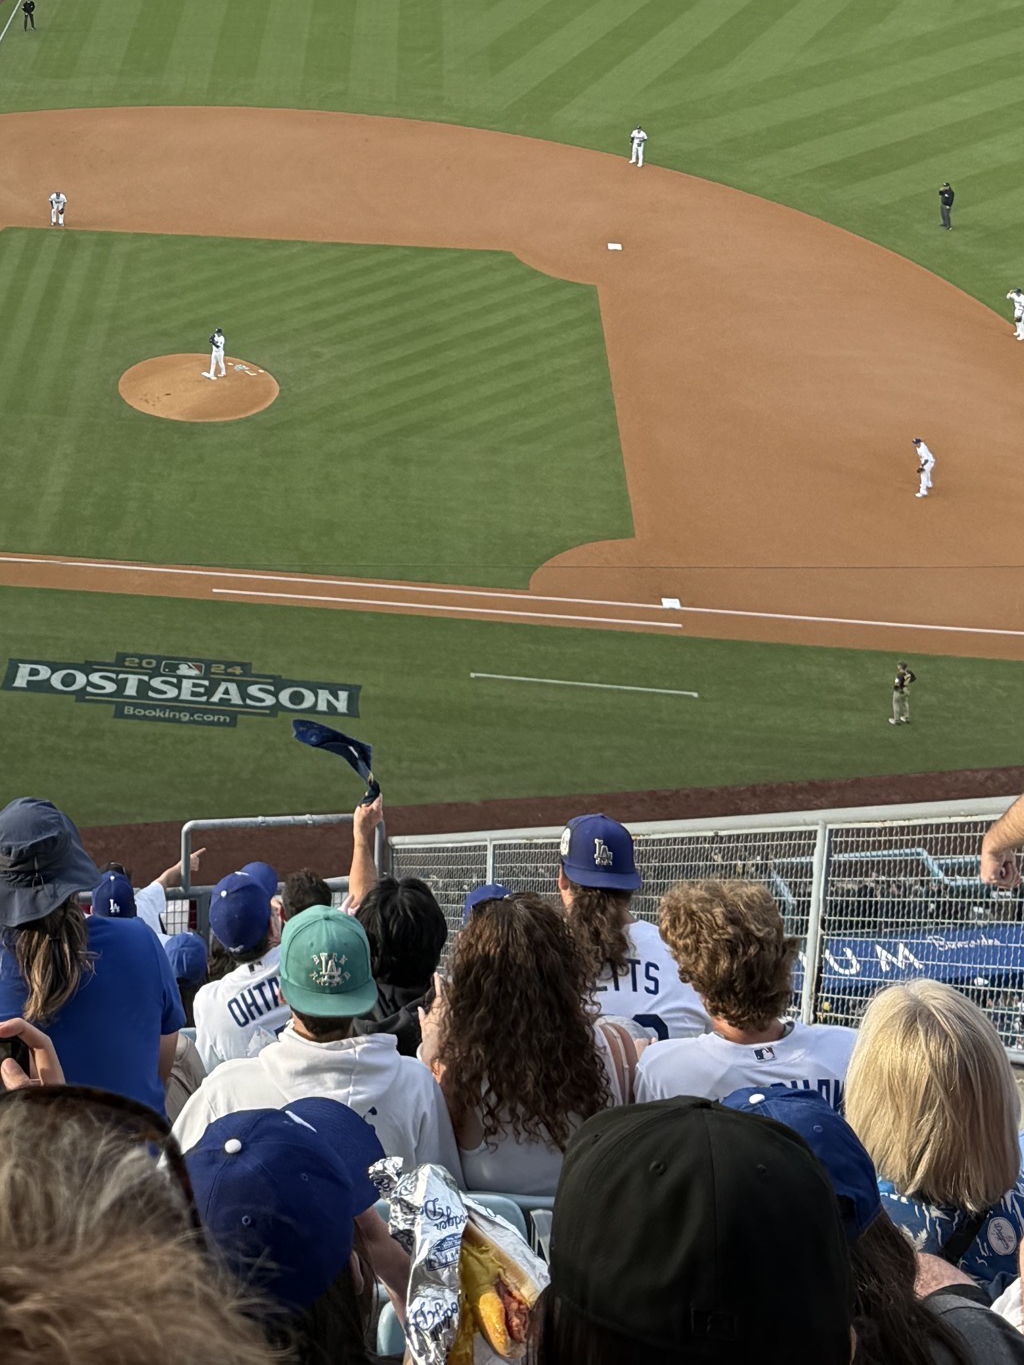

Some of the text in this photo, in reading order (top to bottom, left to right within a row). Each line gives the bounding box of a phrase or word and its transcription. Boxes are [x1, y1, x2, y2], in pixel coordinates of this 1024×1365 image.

[123, 657, 244, 675] 20 24
[12, 662, 350, 714] POSTSEASON
[123, 705, 231, 724] Booking.com
